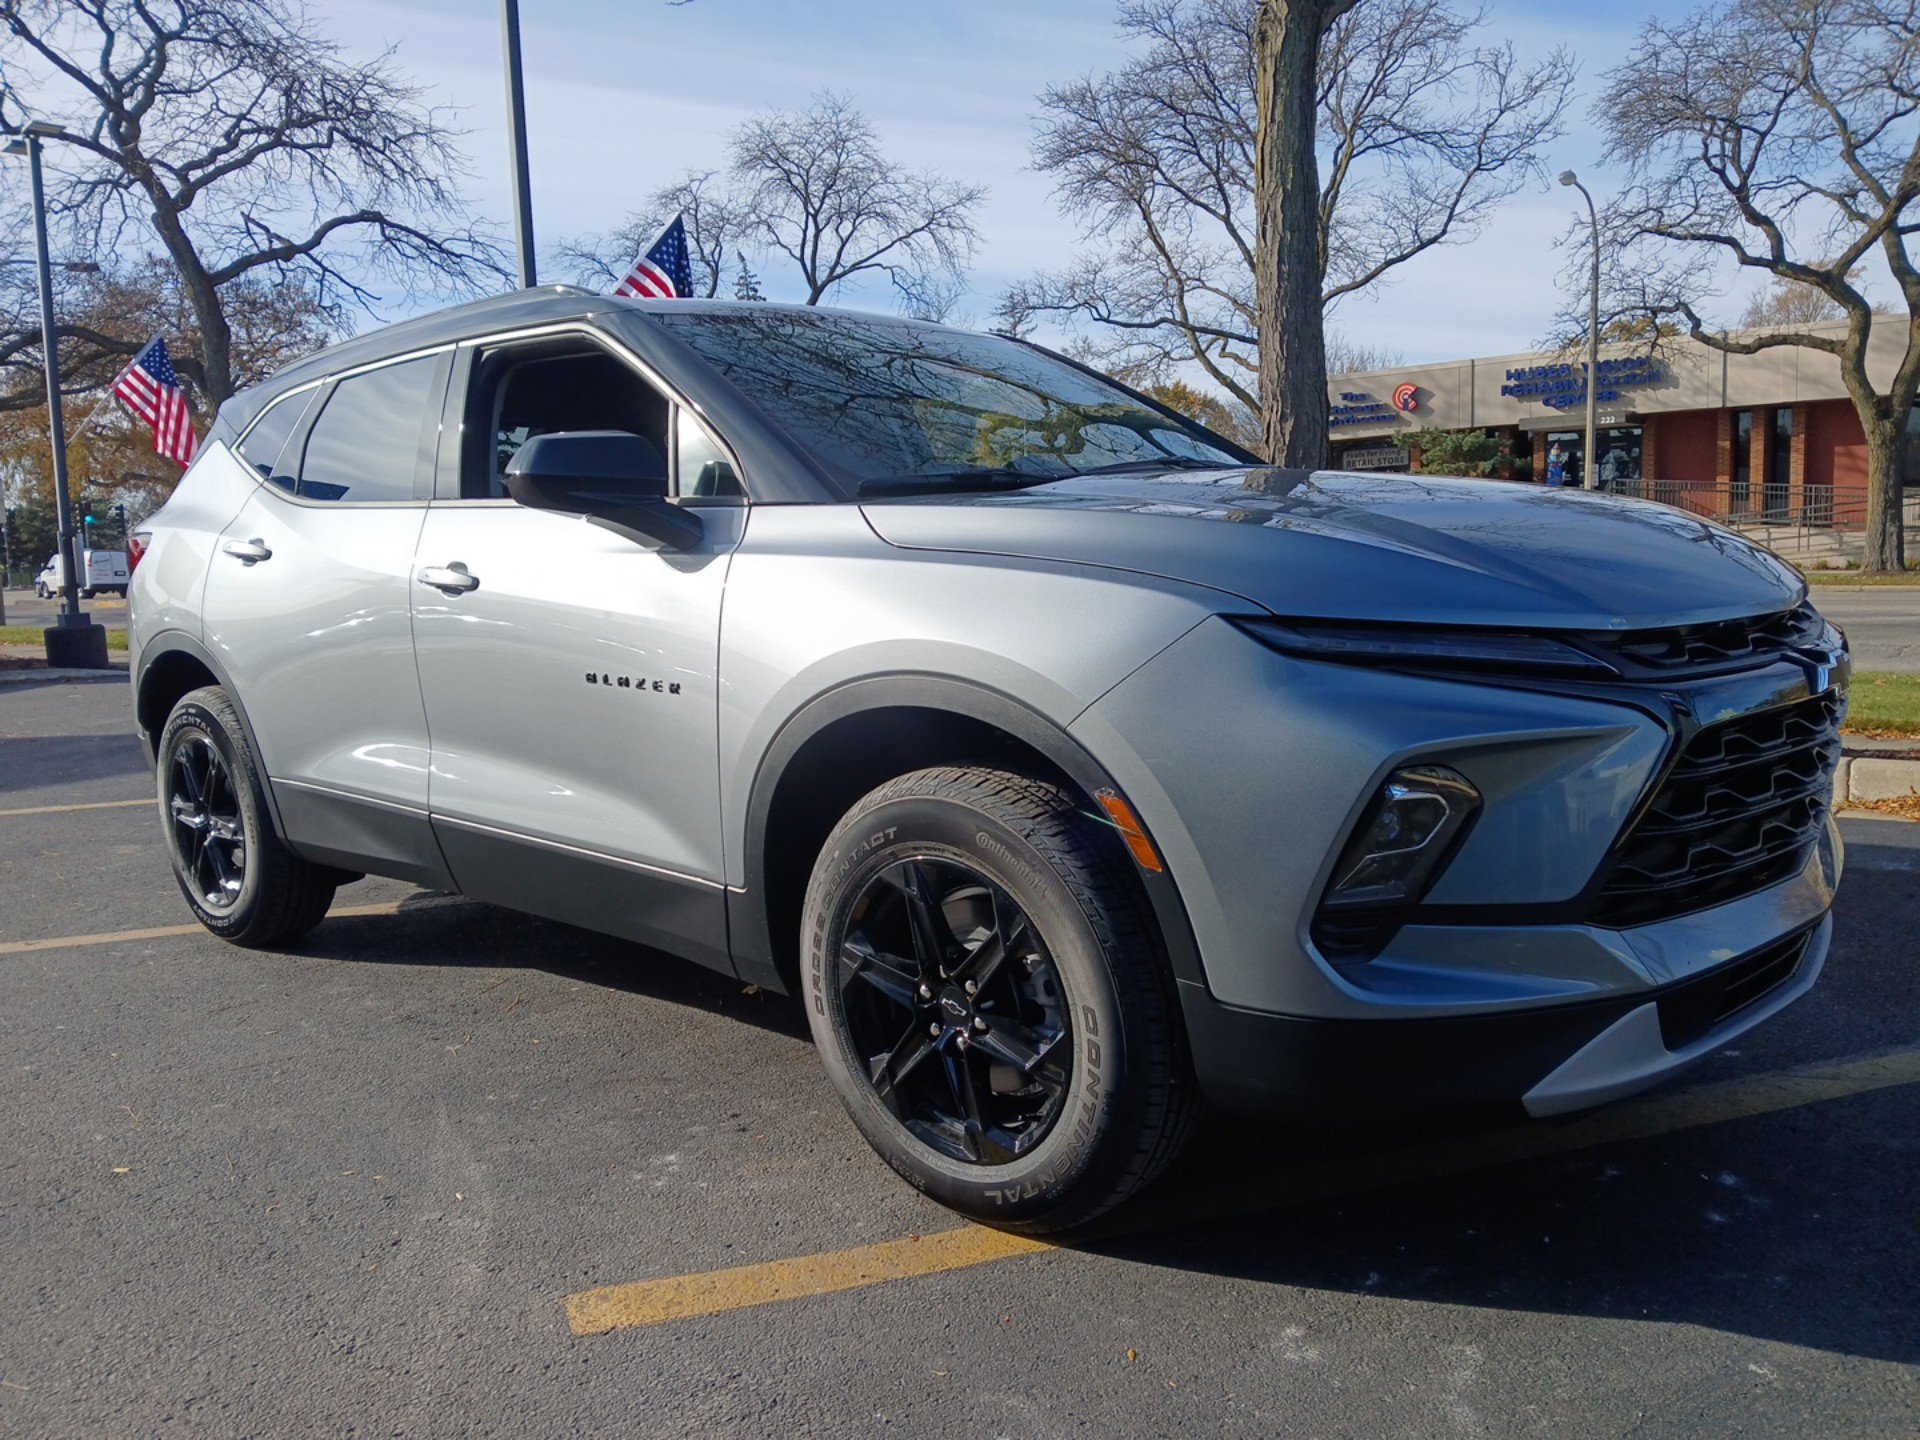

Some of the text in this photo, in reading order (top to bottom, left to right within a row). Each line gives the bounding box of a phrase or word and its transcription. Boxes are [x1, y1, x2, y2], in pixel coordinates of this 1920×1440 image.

[1600, 416, 1616, 424] 222
[1346, 456, 1405, 469] RETAIL STORE
[821, 825, 898, 911] CONTACT
[983, 1002, 1104, 1205] CONTINENTAL
